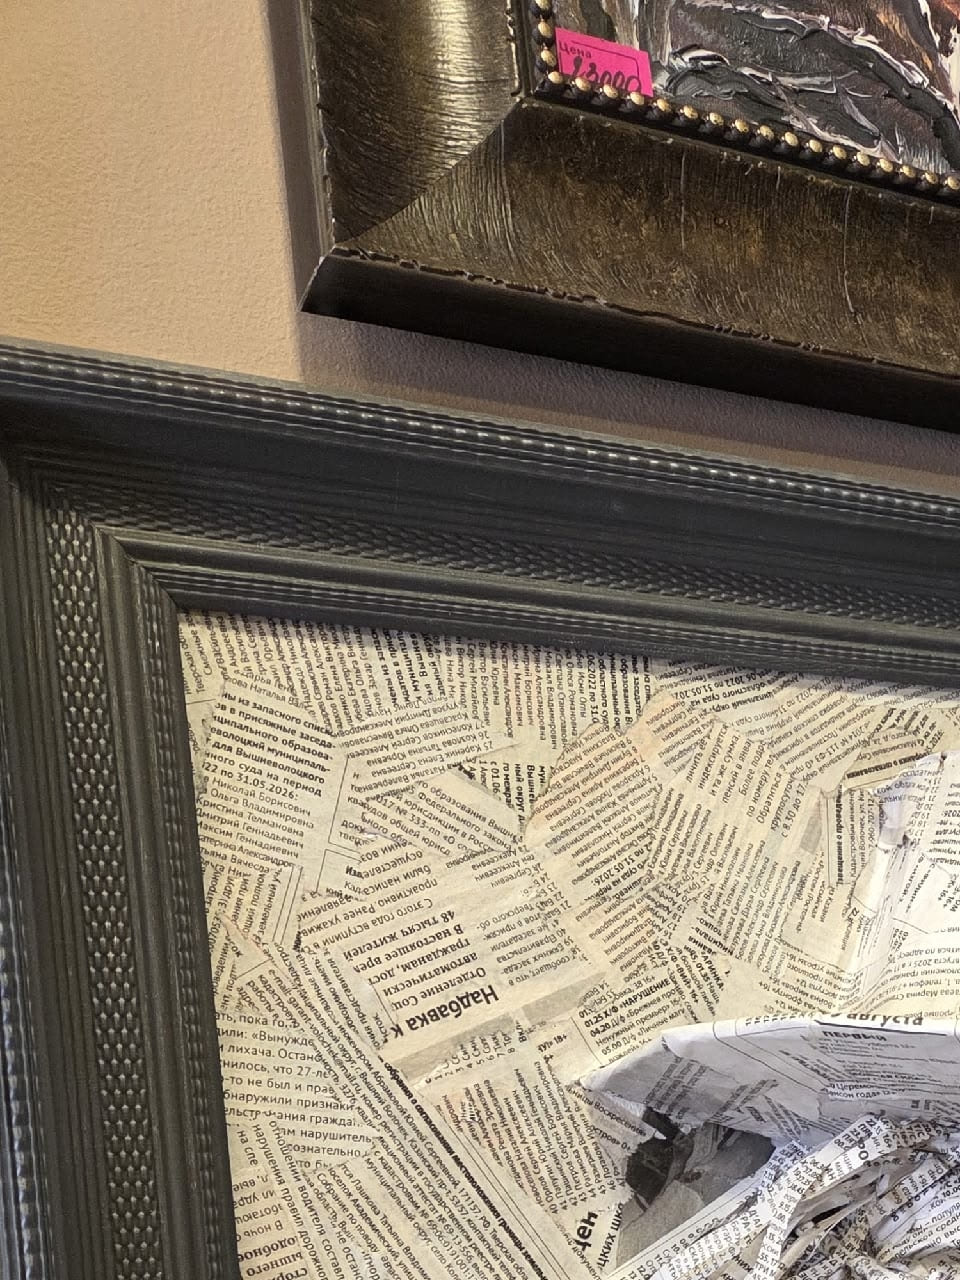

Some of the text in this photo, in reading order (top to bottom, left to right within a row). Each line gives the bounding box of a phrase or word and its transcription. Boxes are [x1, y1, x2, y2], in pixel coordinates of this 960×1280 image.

[212, 741, 233, 753] для
[220, 769, 234, 778] по
[212, 776, 256, 798] Николай
[402, 865, 432, 880] были
[343, 904, 376, 920] Ранее
[371, 912, 395, 927] года
[396, 900, 424, 916] этого
[322, 922, 370, 946] вступили
[343, 910, 454, 962] 48 тысяч жителей
[384, 928, 452, 961] настоящее
[396, 938, 471, 972] гражданам,
[382, 952, 478, 996] автоматически
[419, 967, 486, 999] Отделение
[405, 984, 499, 1031] Надбавка
[247, 1078, 290, 1090] не был
[280, 1188, 304, 1227] правил
[298, 1185, 326, 1236] водителя
